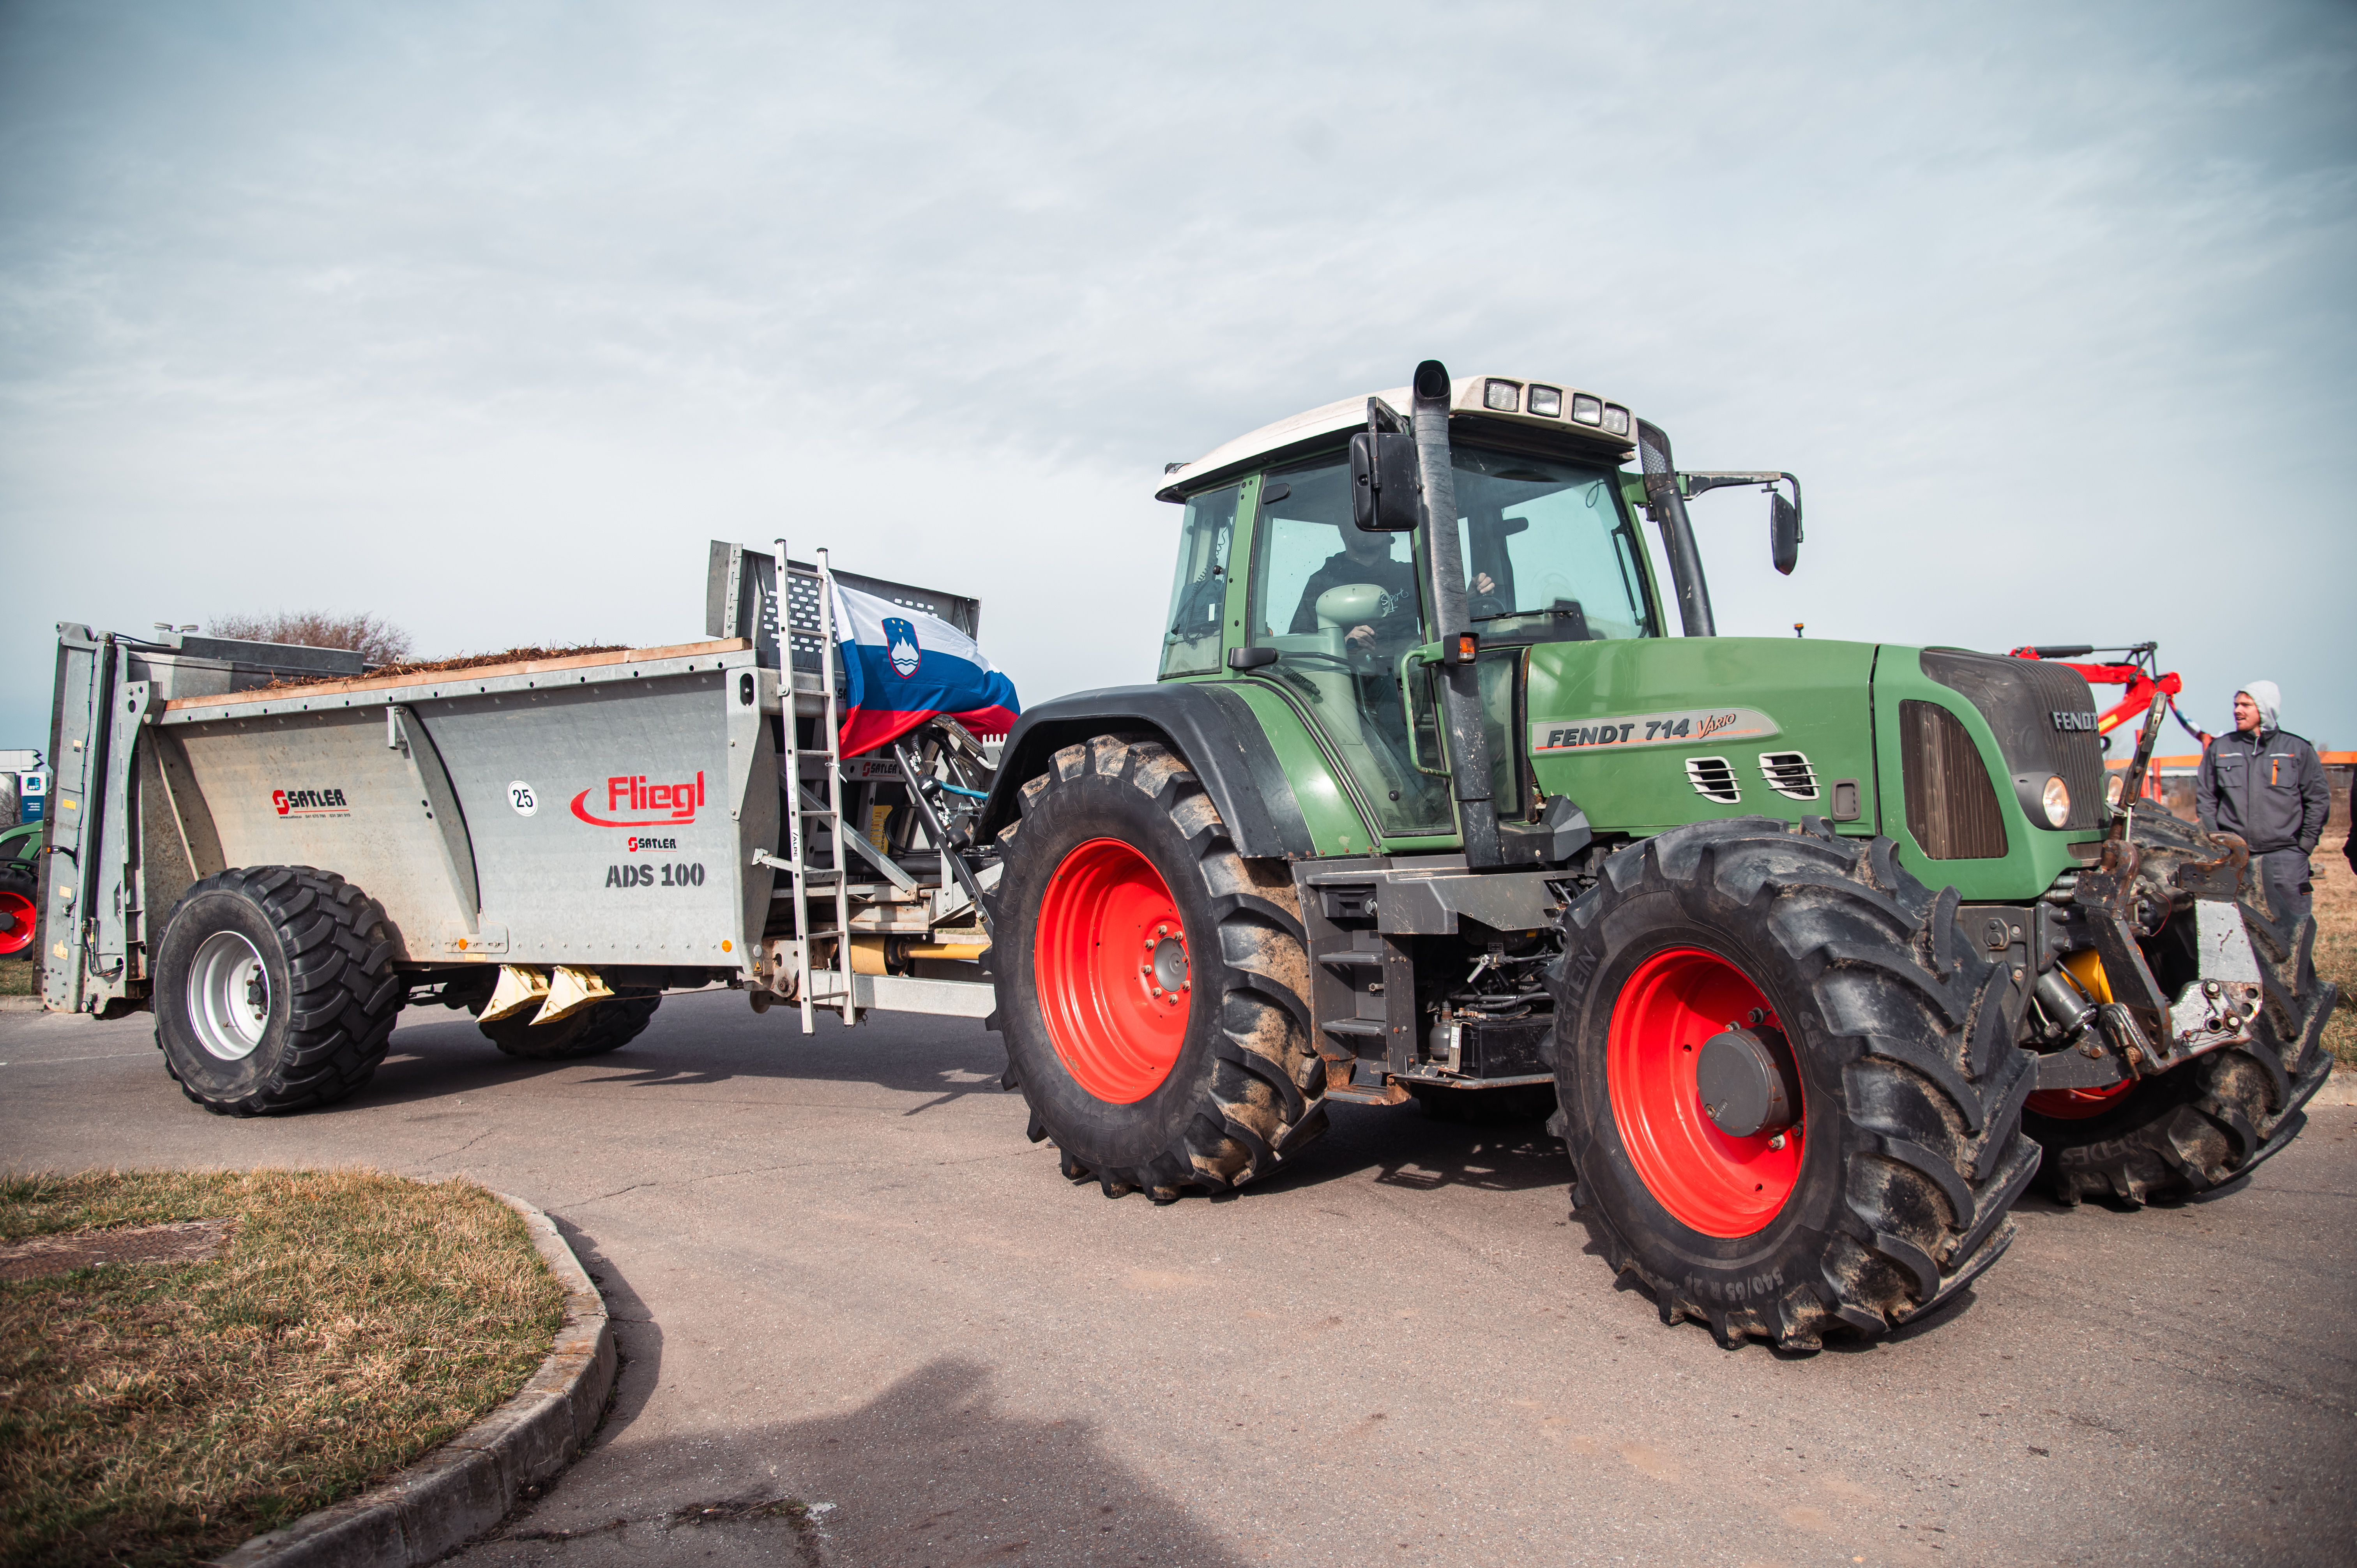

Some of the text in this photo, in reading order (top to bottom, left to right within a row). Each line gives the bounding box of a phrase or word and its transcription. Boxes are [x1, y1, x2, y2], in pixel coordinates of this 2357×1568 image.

[2052, 712, 2098, 730] FENDT
[1547, 724, 1634, 747] FENDT
[1645, 719, 1689, 740] 714
[871, 763, 897, 774] SATLER
[288, 789, 347, 807] SATLER
[513, 789, 534, 808] 25
[608, 770, 705, 818] Fliegl
[639, 838, 677, 849] SATLER
[606, 862, 705, 888] ADS 100
[1798, 1011, 1824, 1049] 65
[1708, 1280, 1722, 1300] R
[1725, 1266, 1785, 1301] 540/65
